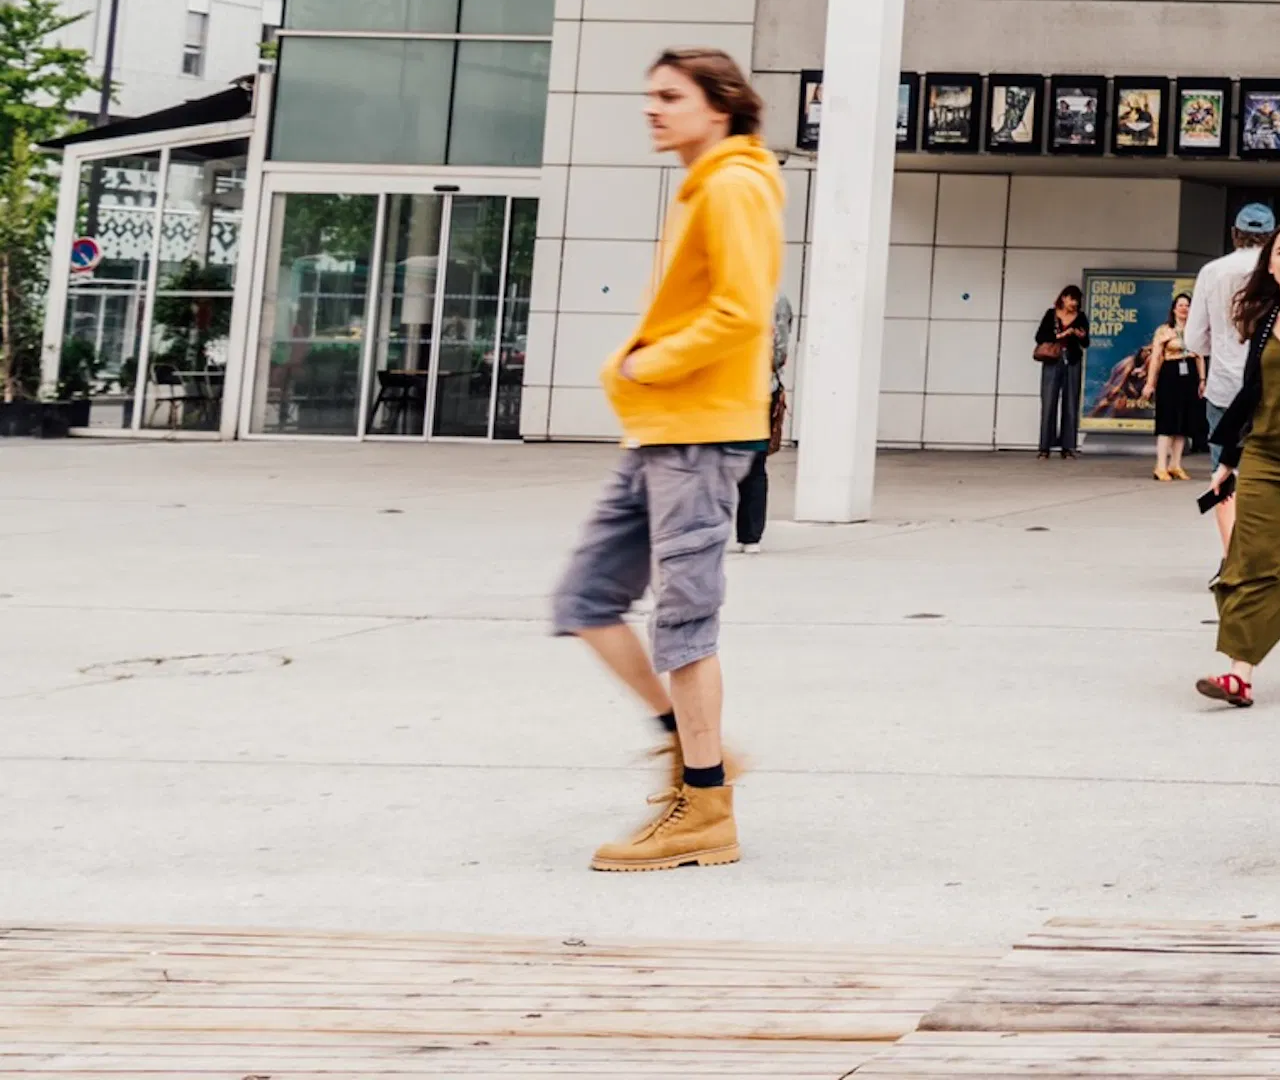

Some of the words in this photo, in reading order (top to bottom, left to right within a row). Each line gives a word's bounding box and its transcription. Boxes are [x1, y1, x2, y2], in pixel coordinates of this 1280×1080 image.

[1091, 280, 1136, 295] GRAND
[1091, 294, 1121, 308] PRIX
[1089, 321, 1124, 336] RATP
